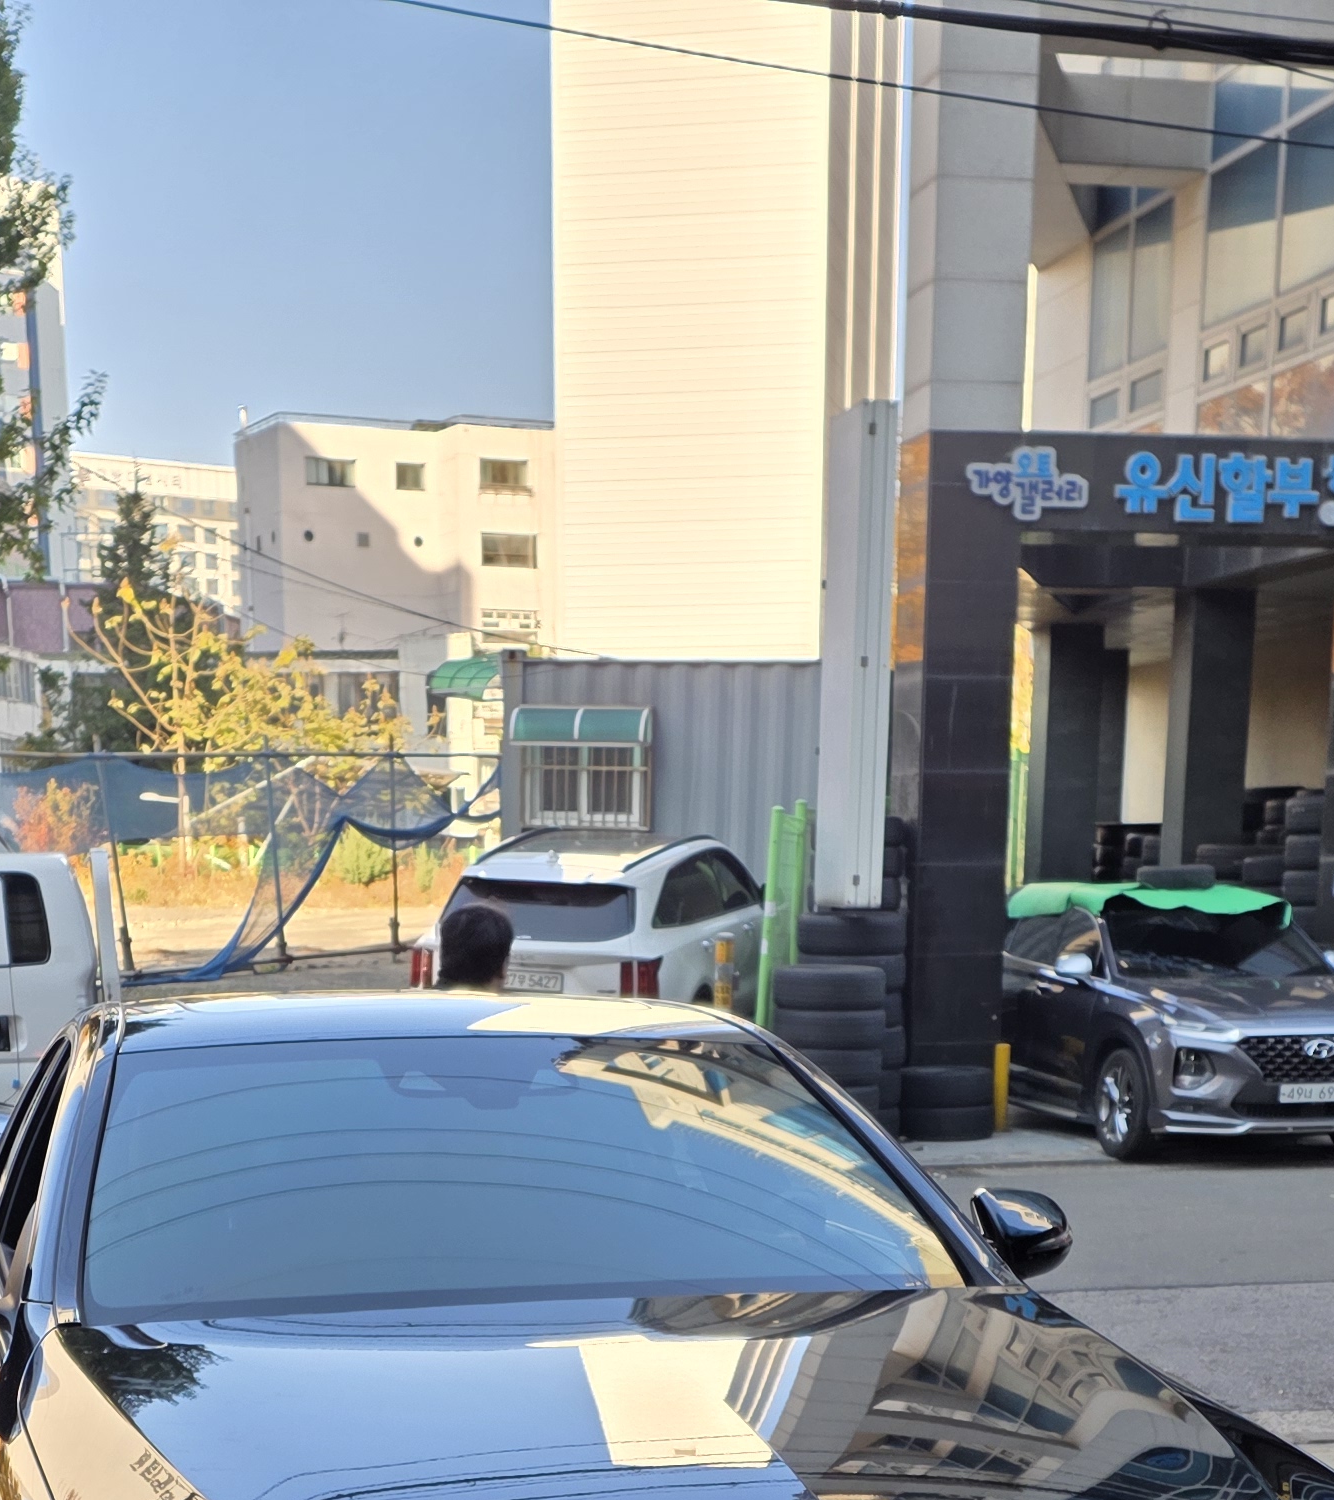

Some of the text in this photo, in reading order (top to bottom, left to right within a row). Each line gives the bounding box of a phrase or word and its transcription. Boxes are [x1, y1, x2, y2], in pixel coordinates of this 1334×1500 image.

[1015, 452, 1054, 479] 오토
[973, 469, 1013, 499] 가양
[1015, 479, 1083, 515] 갤러리
[1115, 451, 1320, 524] 유신할부
[528, 974, 559, 989] 5427
